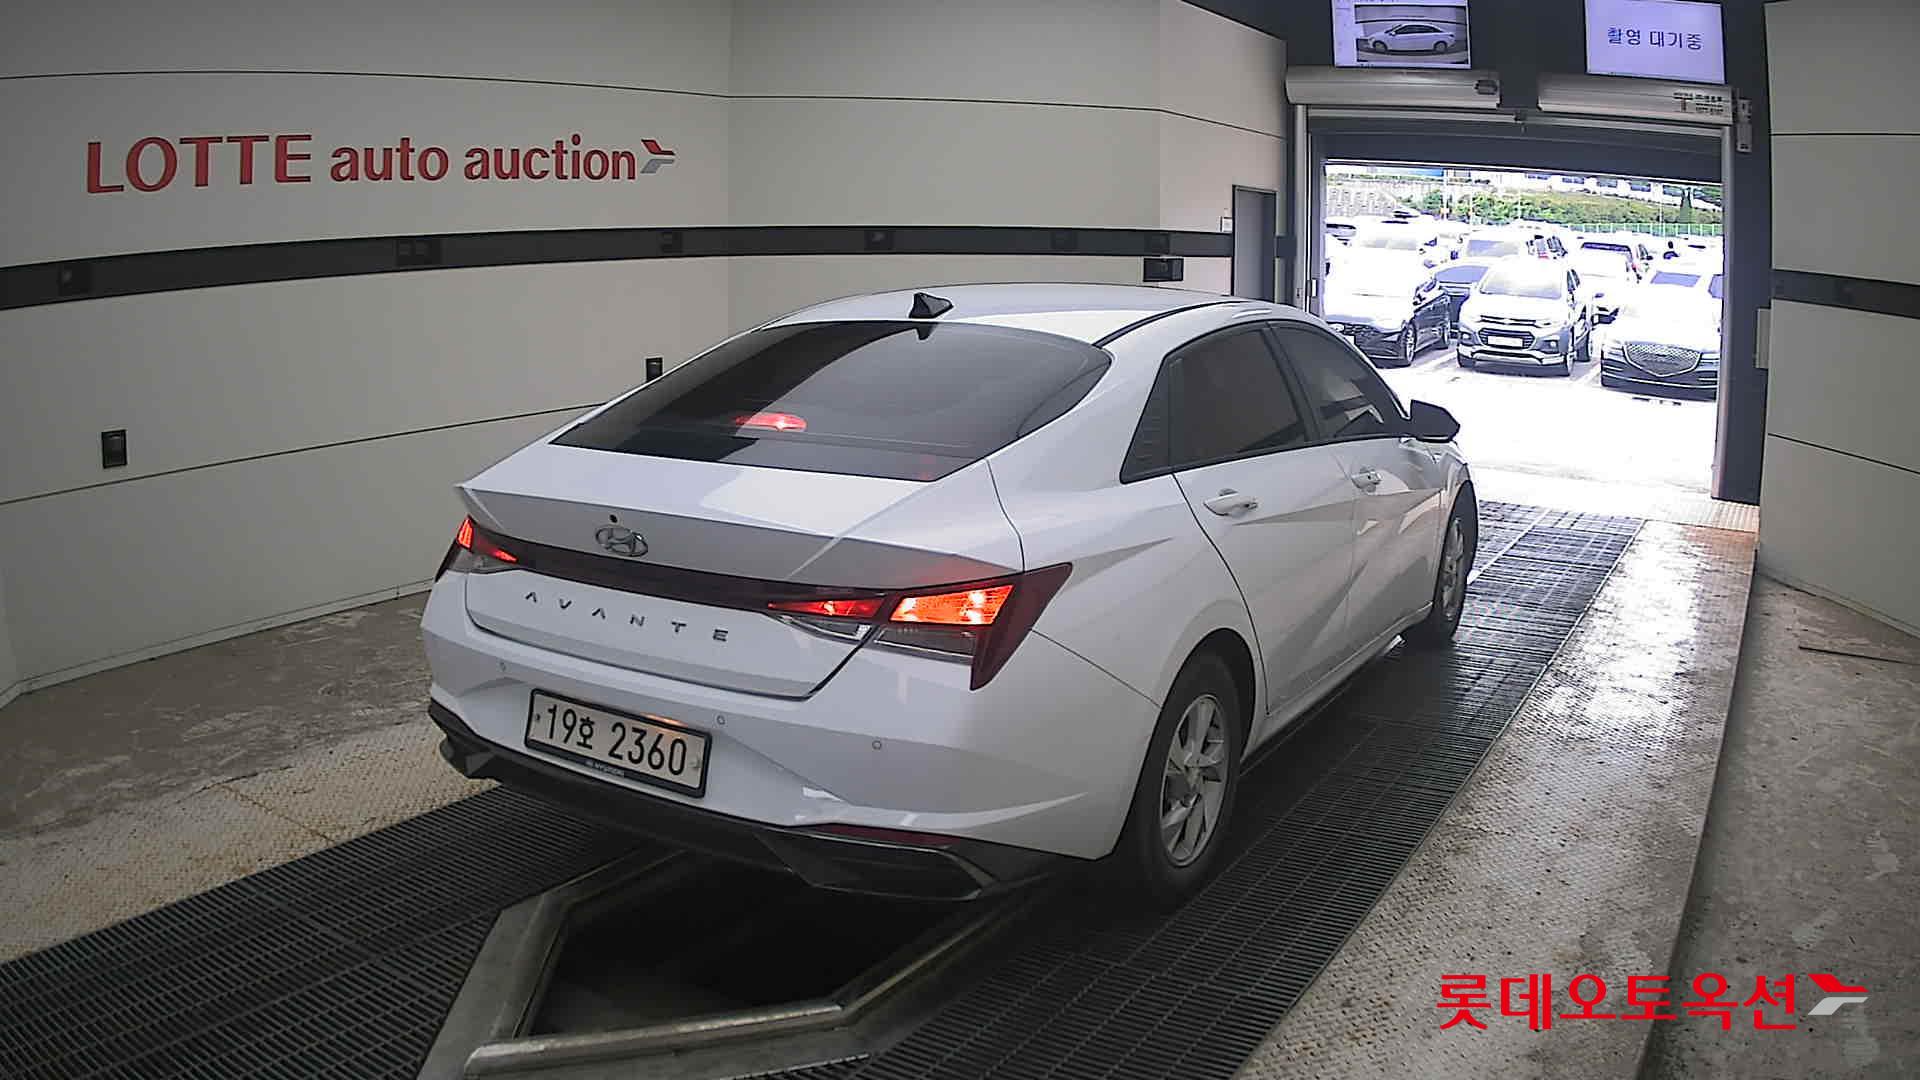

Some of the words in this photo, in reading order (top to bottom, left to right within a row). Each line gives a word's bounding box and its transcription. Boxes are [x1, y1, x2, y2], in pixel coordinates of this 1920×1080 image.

[1649, 30, 1702, 50] 대기중
[86, 134, 312, 194] LOTTE
[330, 137, 449, 182] auto
[463, 134, 636, 181] auction
[525, 590, 729, 642] AVANTE
[547, 703, 595, 750] 19호
[608, 722, 687, 776] 2360
